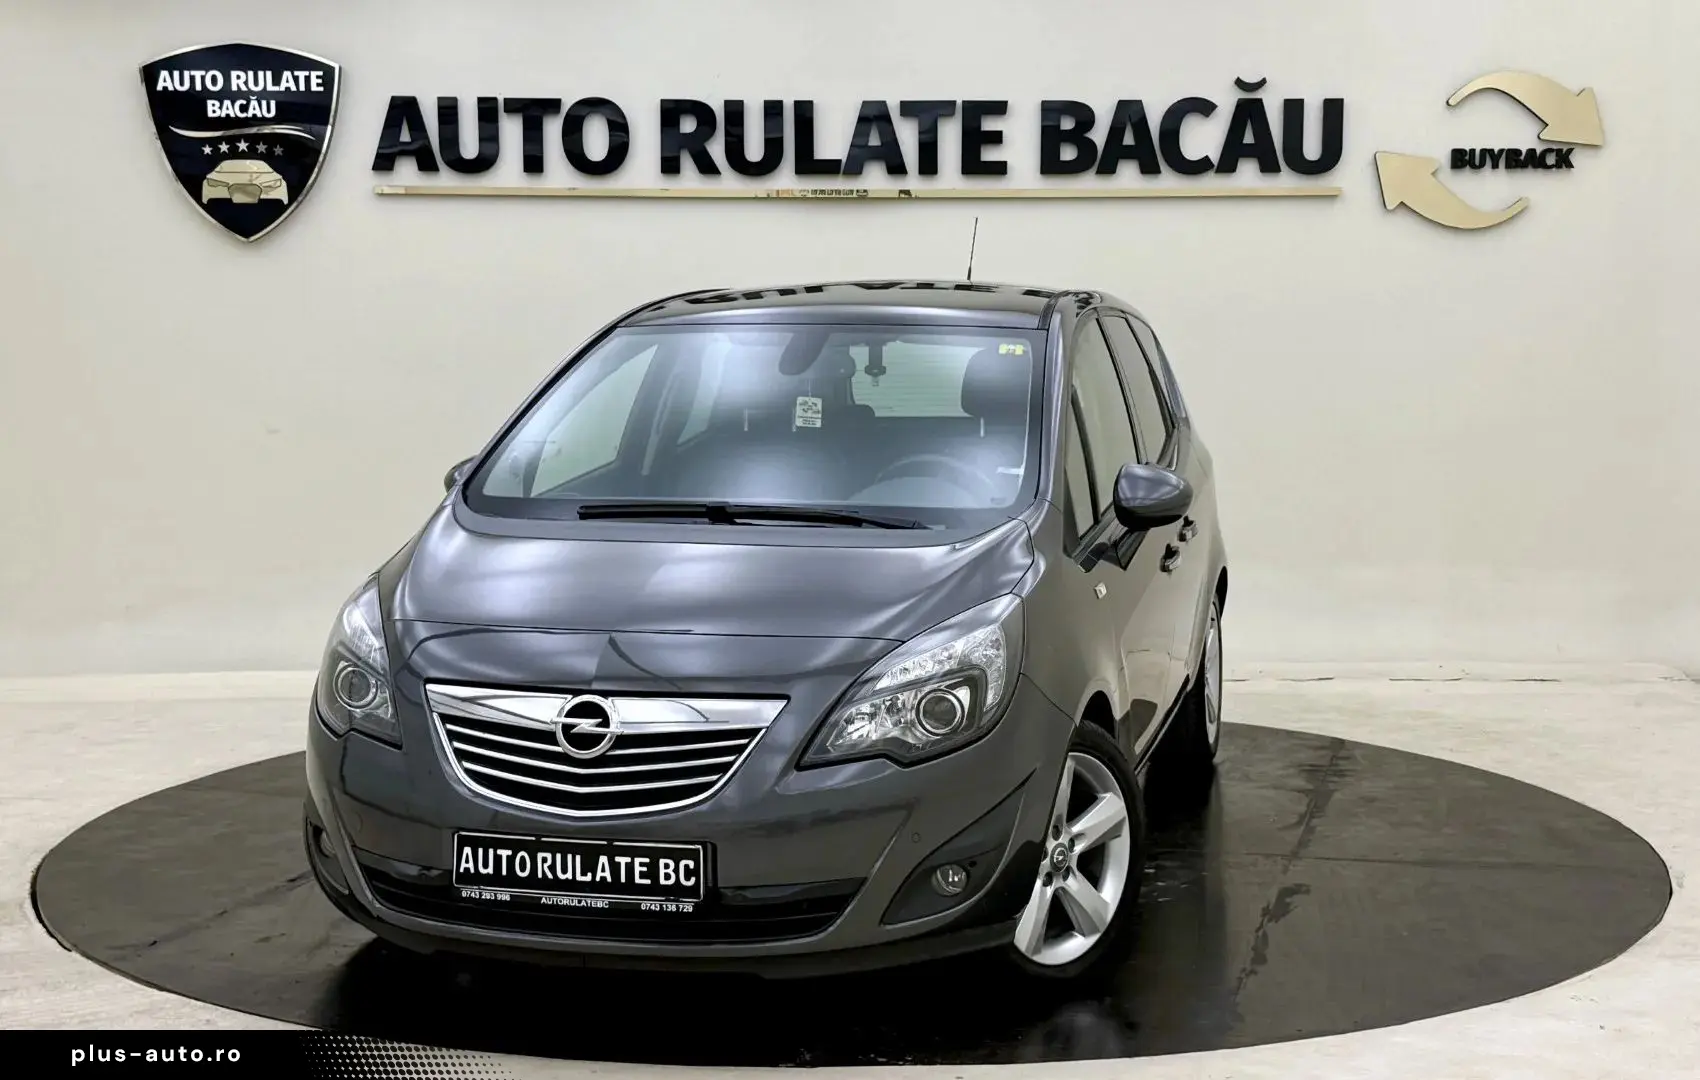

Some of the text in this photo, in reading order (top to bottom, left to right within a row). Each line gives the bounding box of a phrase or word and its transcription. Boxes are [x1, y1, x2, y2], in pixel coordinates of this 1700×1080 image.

[156, 70, 325, 92] AUTO RULATE
[206, 96, 277, 119] BACĂU
[371, 76, 1345, 177] AUTO RULATE BACĂU
[1449, 147, 1576, 171] BUYBACK
[659, 858, 697, 887] BC
[461, 890, 480, 899] 0743
[540, 896, 609, 908] AUTORULATEBC
[640, 902, 693, 913] 0743 136 729
